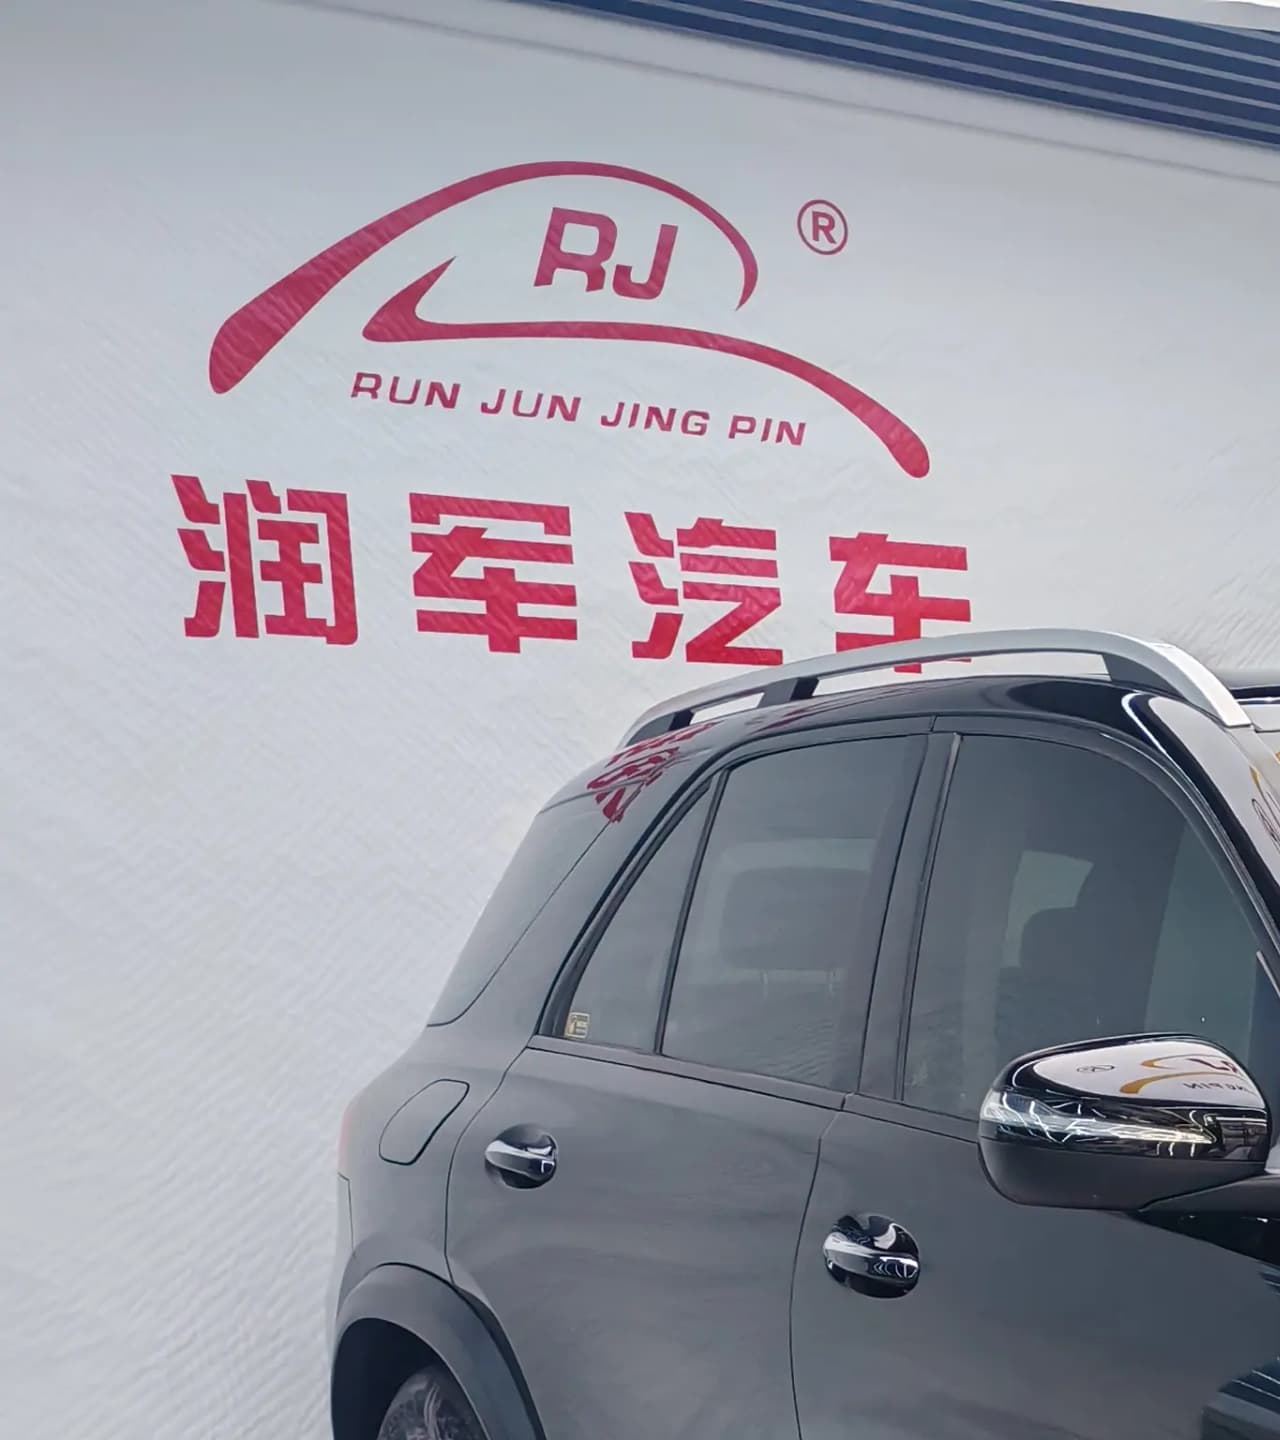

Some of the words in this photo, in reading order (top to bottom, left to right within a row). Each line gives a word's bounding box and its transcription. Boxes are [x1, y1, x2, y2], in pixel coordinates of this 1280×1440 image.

[534, 207, 680, 300] RJ
[351, 371, 461, 411] RUN
[480, 387, 582, 423] JUN
[600, 401, 710, 438] JING
[728, 415, 807, 447] PIN
[171, 474, 972, 675] 润军汽车
